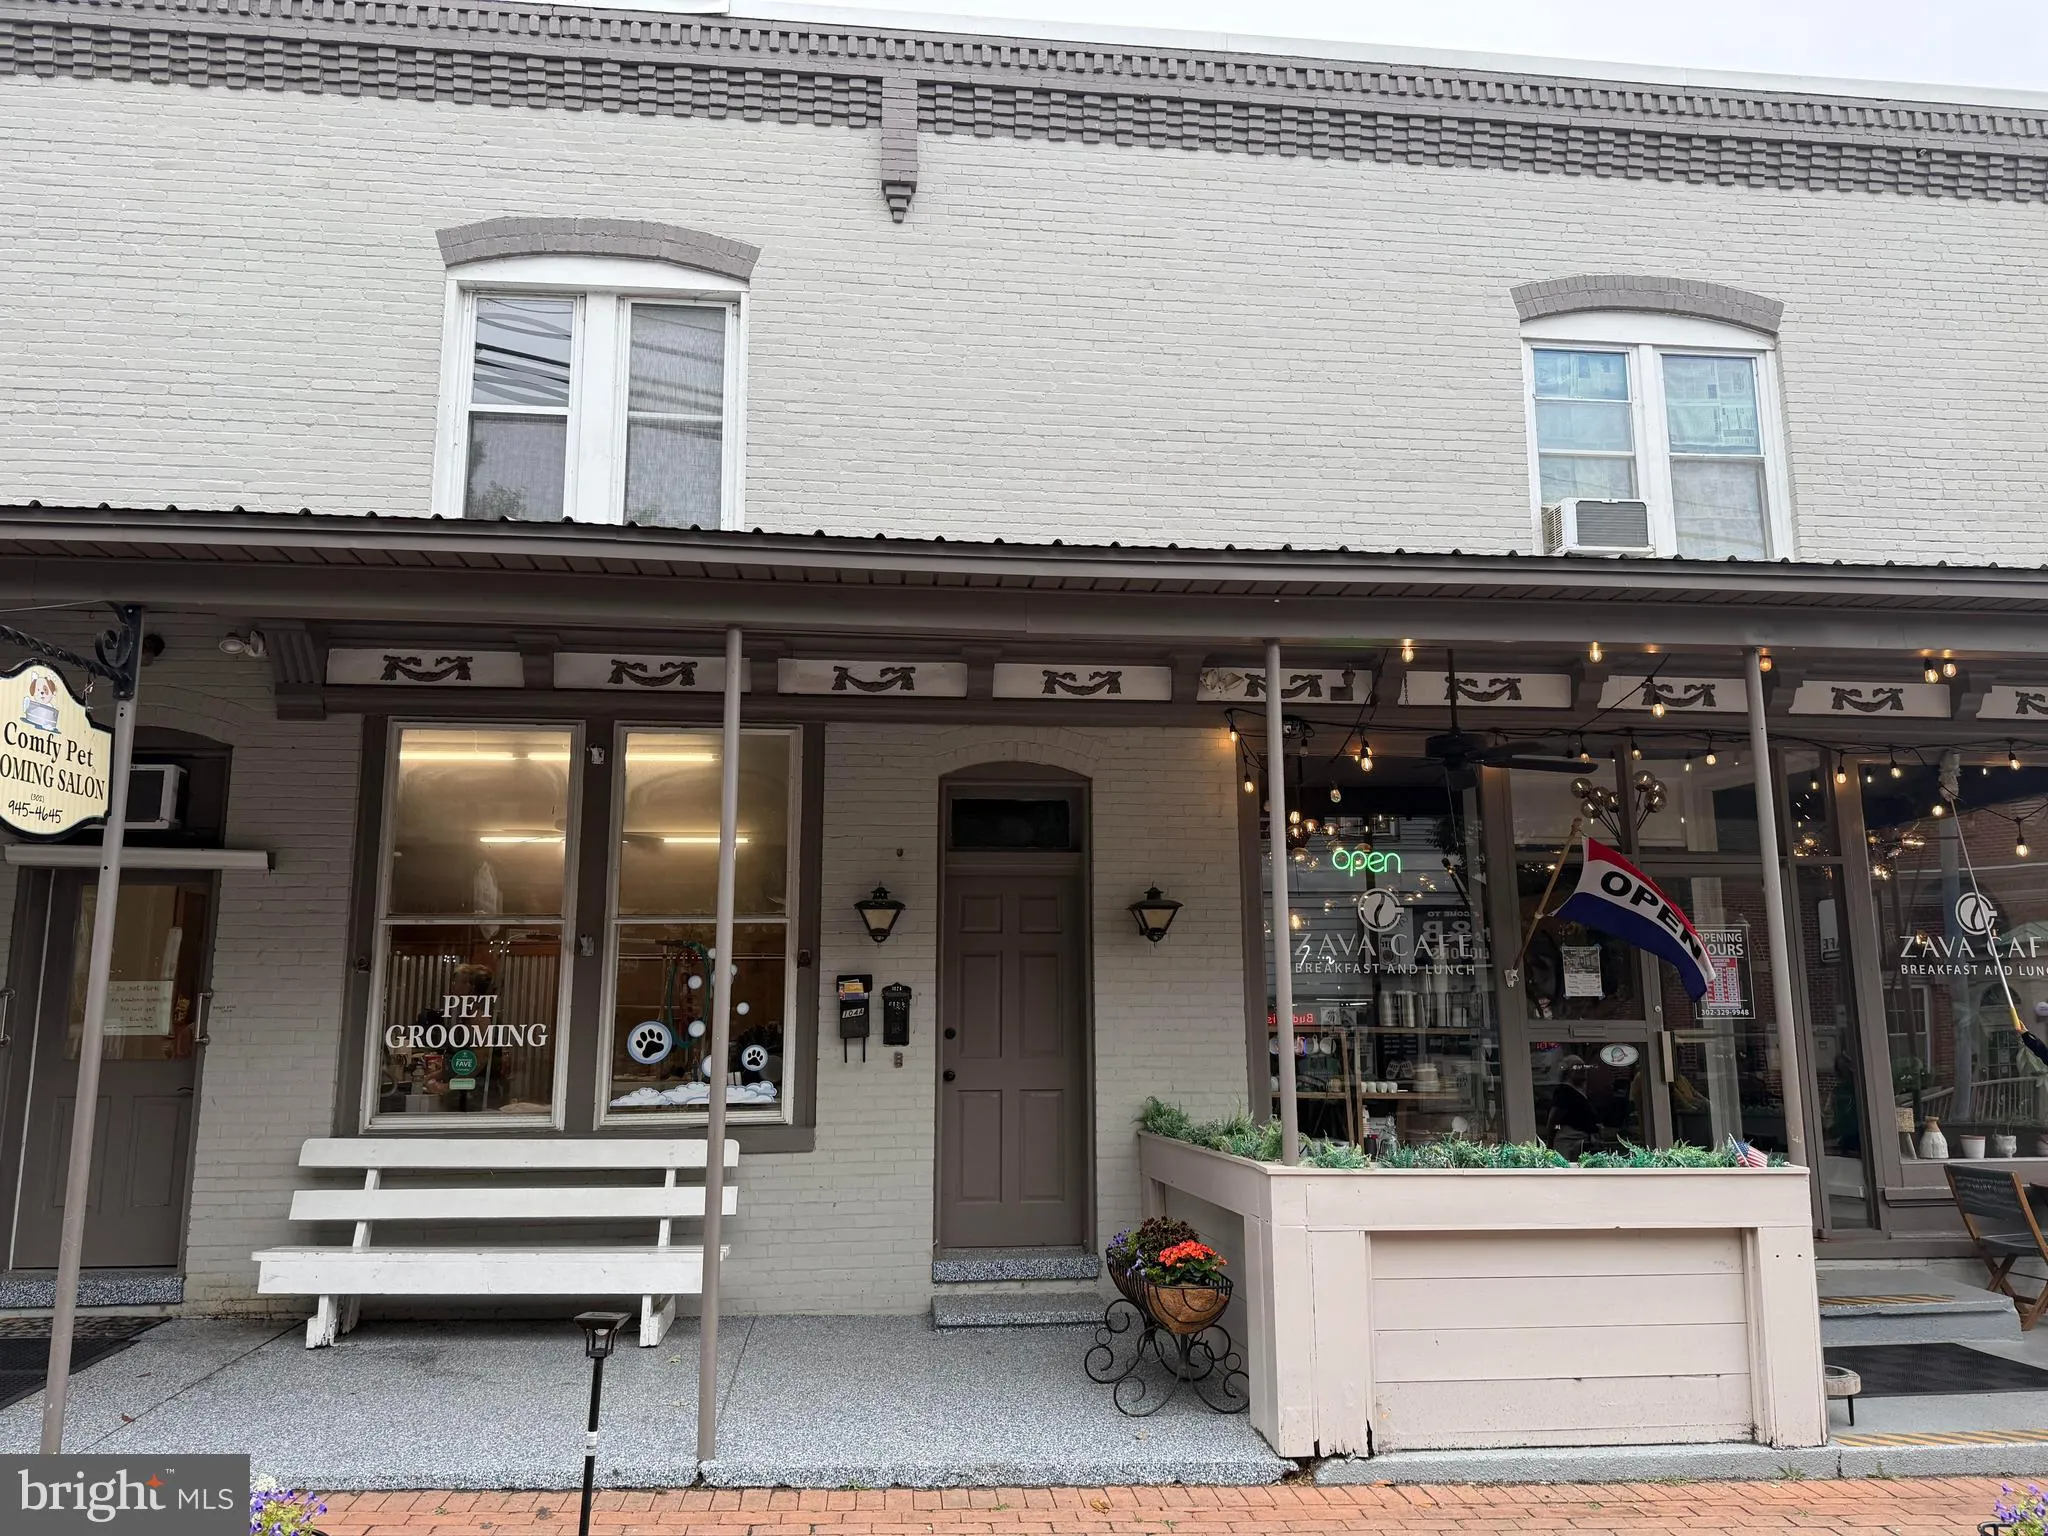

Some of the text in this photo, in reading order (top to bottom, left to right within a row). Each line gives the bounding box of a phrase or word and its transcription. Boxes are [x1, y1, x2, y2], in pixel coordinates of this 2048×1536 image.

[4, 721, 94, 767] Comfy Pet
[0, 754, 105, 800] OMING SALON
[8, 799, 63, 824] 945-4645
[1332, 849, 1402, 877] open
[1600, 870, 1703, 960] OPEN
[1294, 933, 1377, 957] ZAVA
[1391, 933, 1473, 957] CAFE
[1706, 943, 1745, 956] OURS
[1899, 935, 2042, 958] ZAVA CAF
[1295, 962, 1475, 976] BREAKFAST AND LUNCH
[1900, 964, 1978, 975] BREAKFAST
[2018, 965, 2048, 976] LUN
[442, 994, 498, 1019] PET
[384, 1023, 549, 1049] GROOMING
